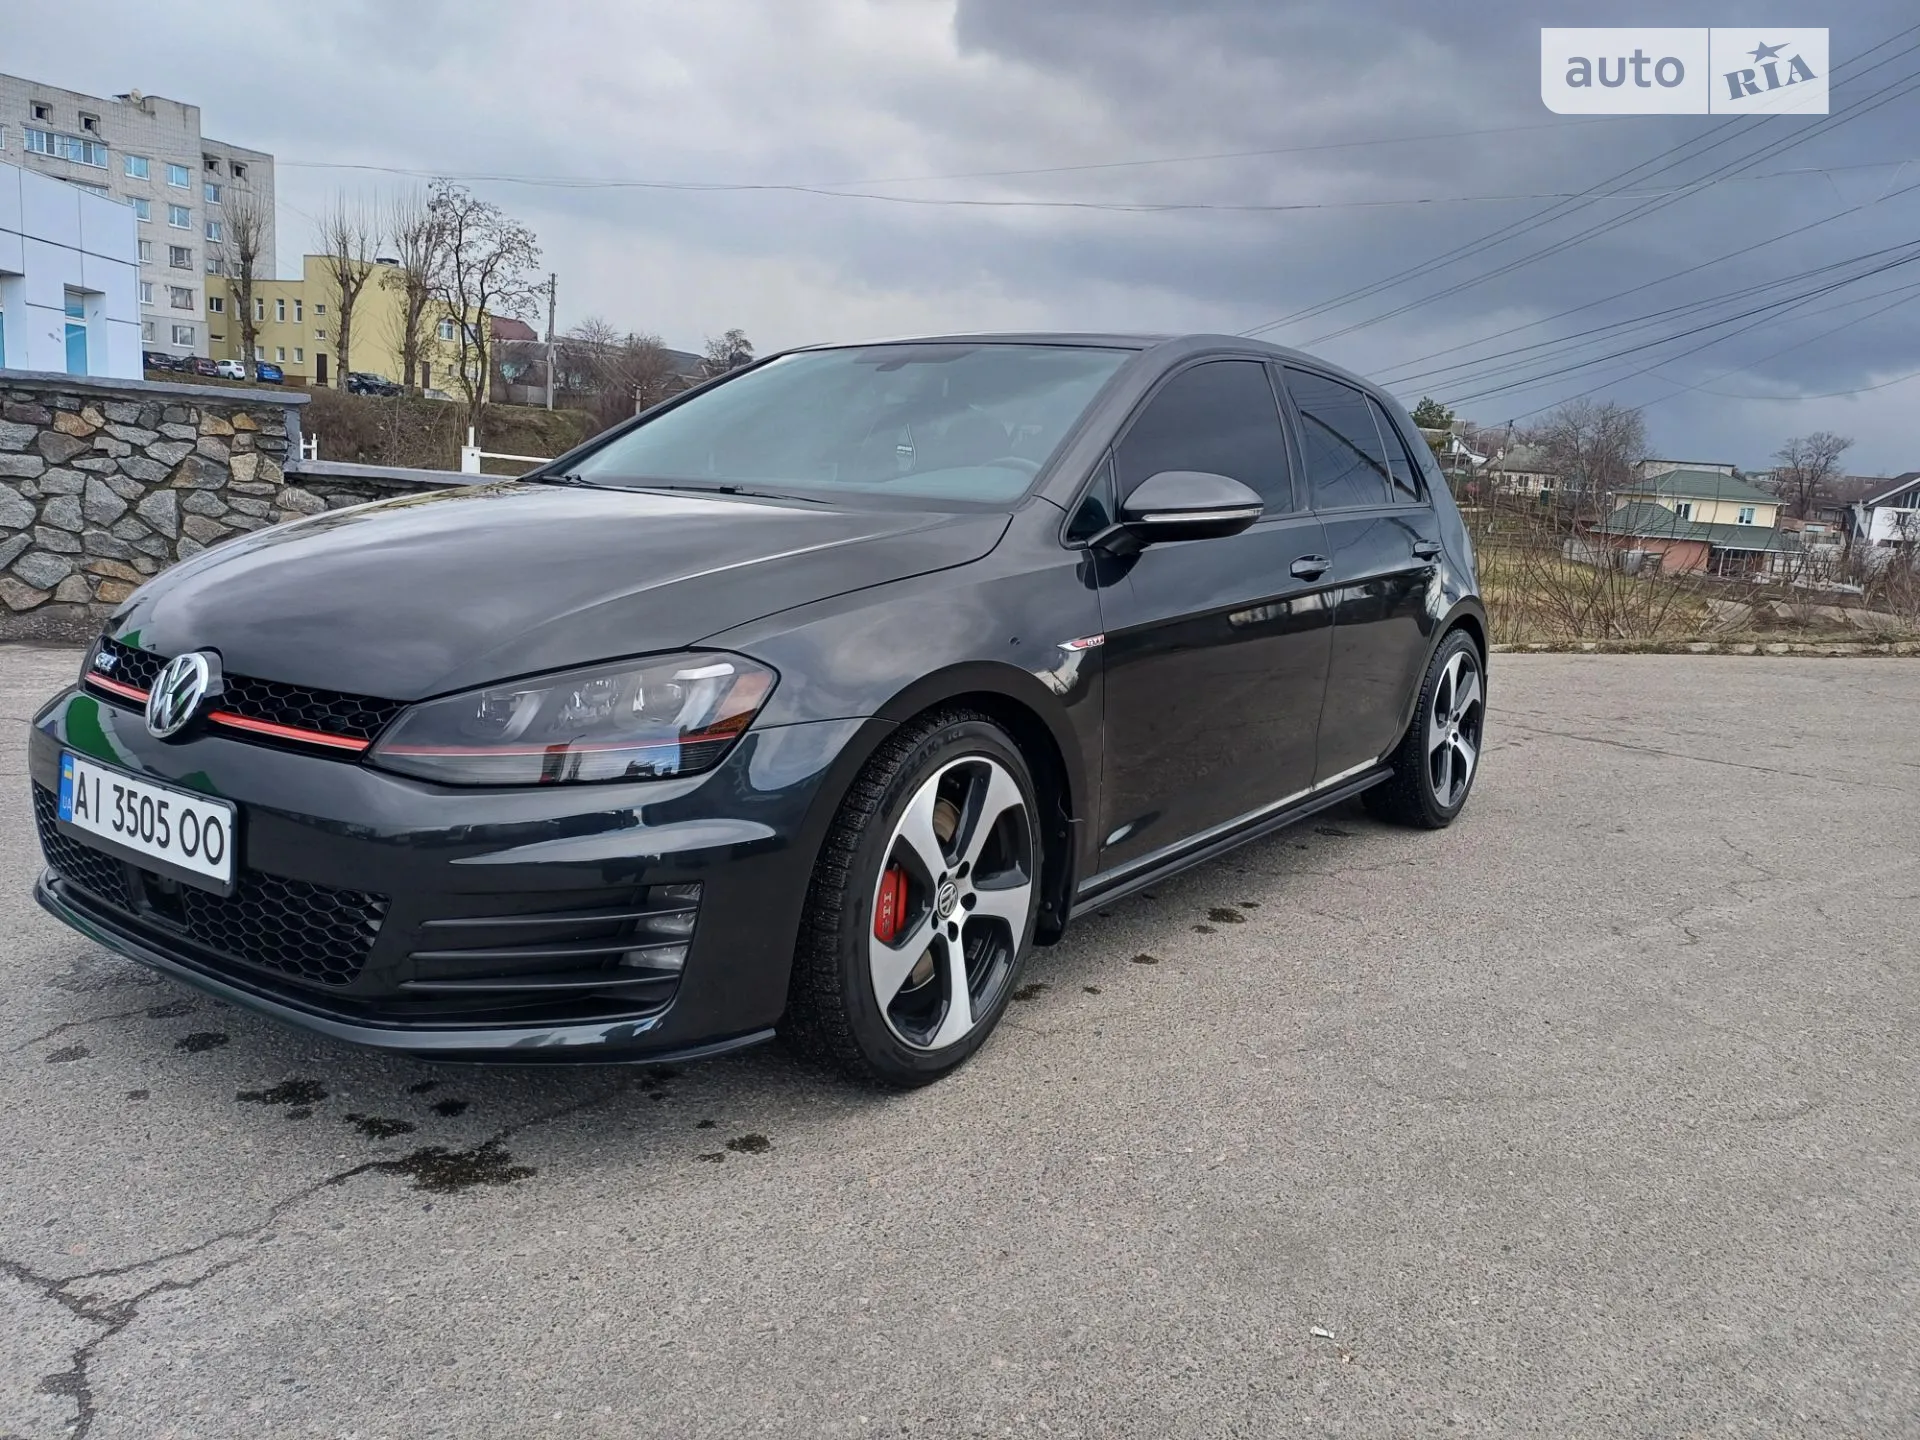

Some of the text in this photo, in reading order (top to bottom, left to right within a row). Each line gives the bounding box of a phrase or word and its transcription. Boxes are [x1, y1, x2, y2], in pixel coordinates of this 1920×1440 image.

[63, 796, 71, 811] UA
[75, 771, 100, 823] AI
[112, 783, 170, 849] 3505
